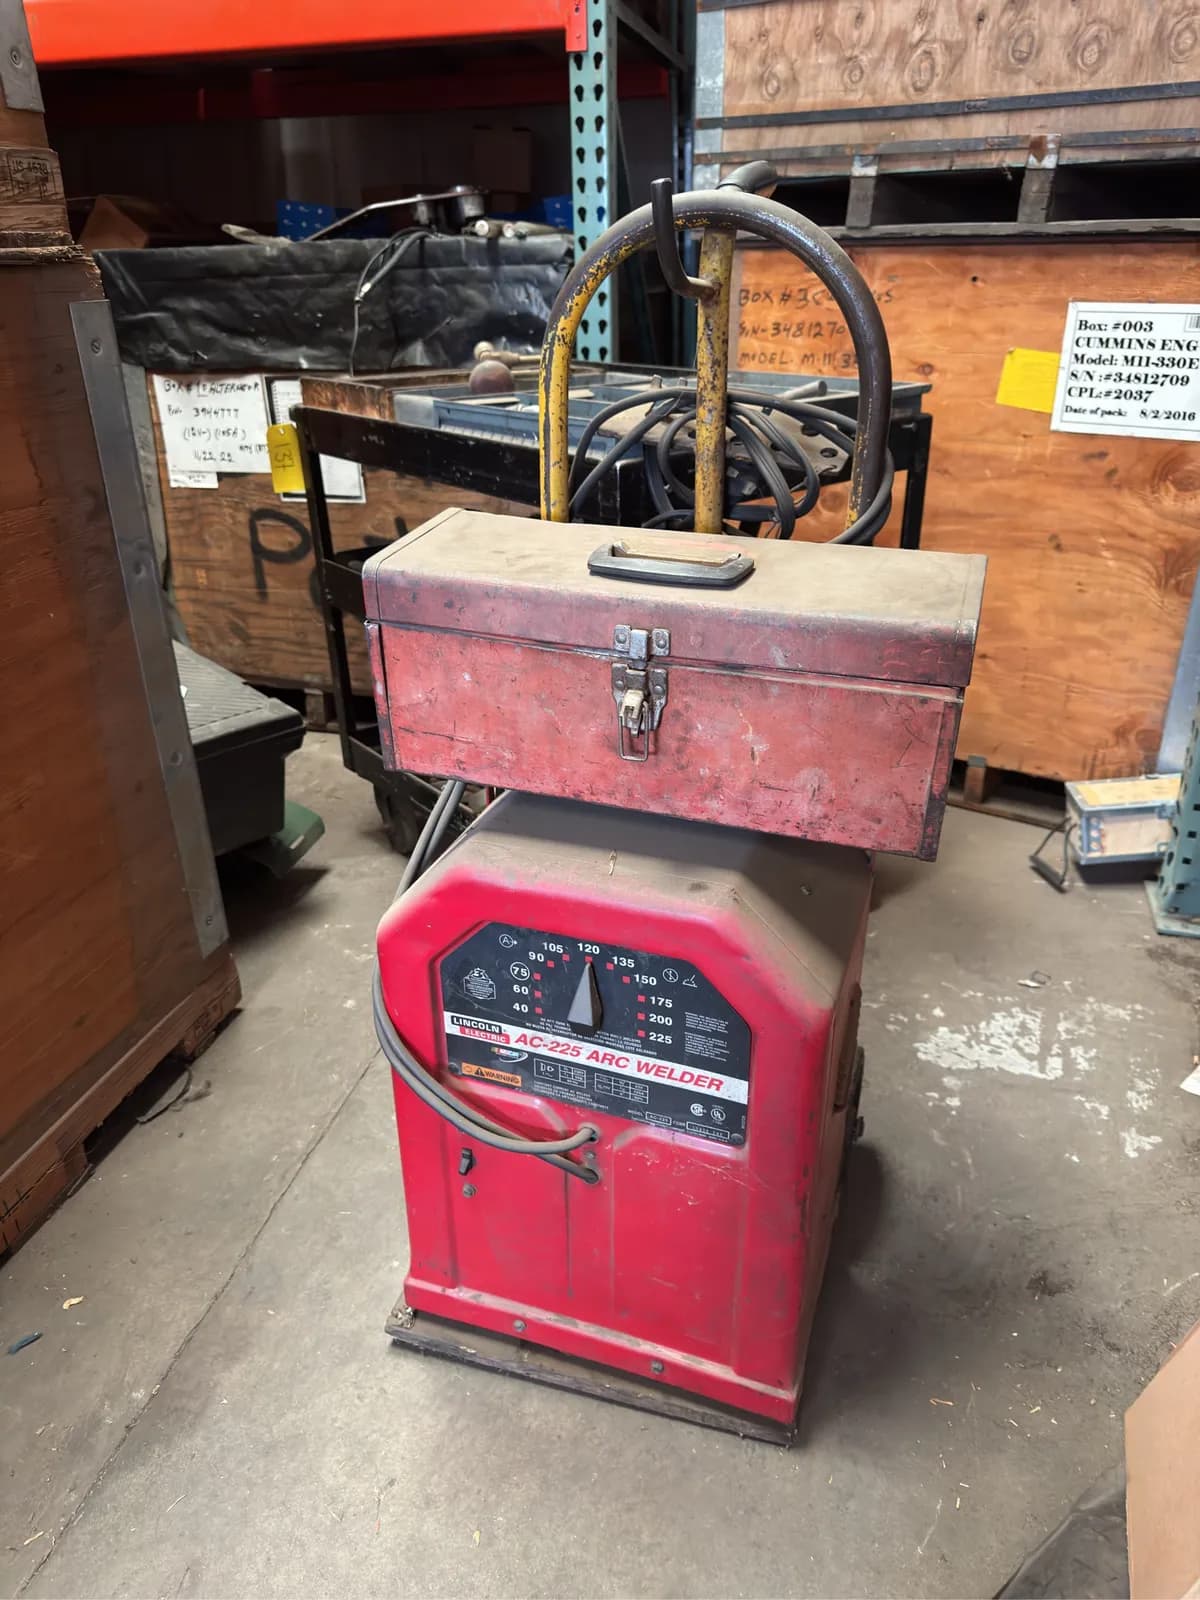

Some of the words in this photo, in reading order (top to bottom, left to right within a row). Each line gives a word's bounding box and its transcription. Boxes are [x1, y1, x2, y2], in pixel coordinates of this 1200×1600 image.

[1077, 319, 1108, 332] Box:
[1111, 320, 1154, 333] #003
[1075, 336, 1156, 350] CUMMINS
[1160, 339, 1199, 352] ENG
[1071, 353, 1118, 366] Model:
[1064, 405, 1087, 415] Date
[1089, 406, 1100, 415] of
[1100, 407, 1127, 418] pack:
[1139, 409, 1197, 422] 8/2/2016
[543, 942, 564, 954] 105
[577, 943, 600, 955] 120
[528, 951, 544, 962] 90
[612, 956, 635, 968] 135
[512, 966, 528, 977] 75
[634, 974, 657, 986] 150
[513, 984, 529, 995] 60
[512, 1002, 529, 1013] 40
[650, 997, 673, 1008] 175
[453, 1016, 500, 1033] LINCOLN
[649, 1014, 673, 1026] 200
[464, 1028, 508, 1043] ELECTRIC
[649, 1033, 673, 1045] 225
[515, 1033, 583, 1058] AC-225
[586, 1050, 630, 1069] ARC
[636, 1060, 724, 1092] WELDER
[484, 1069, 520, 1085] WARNING
